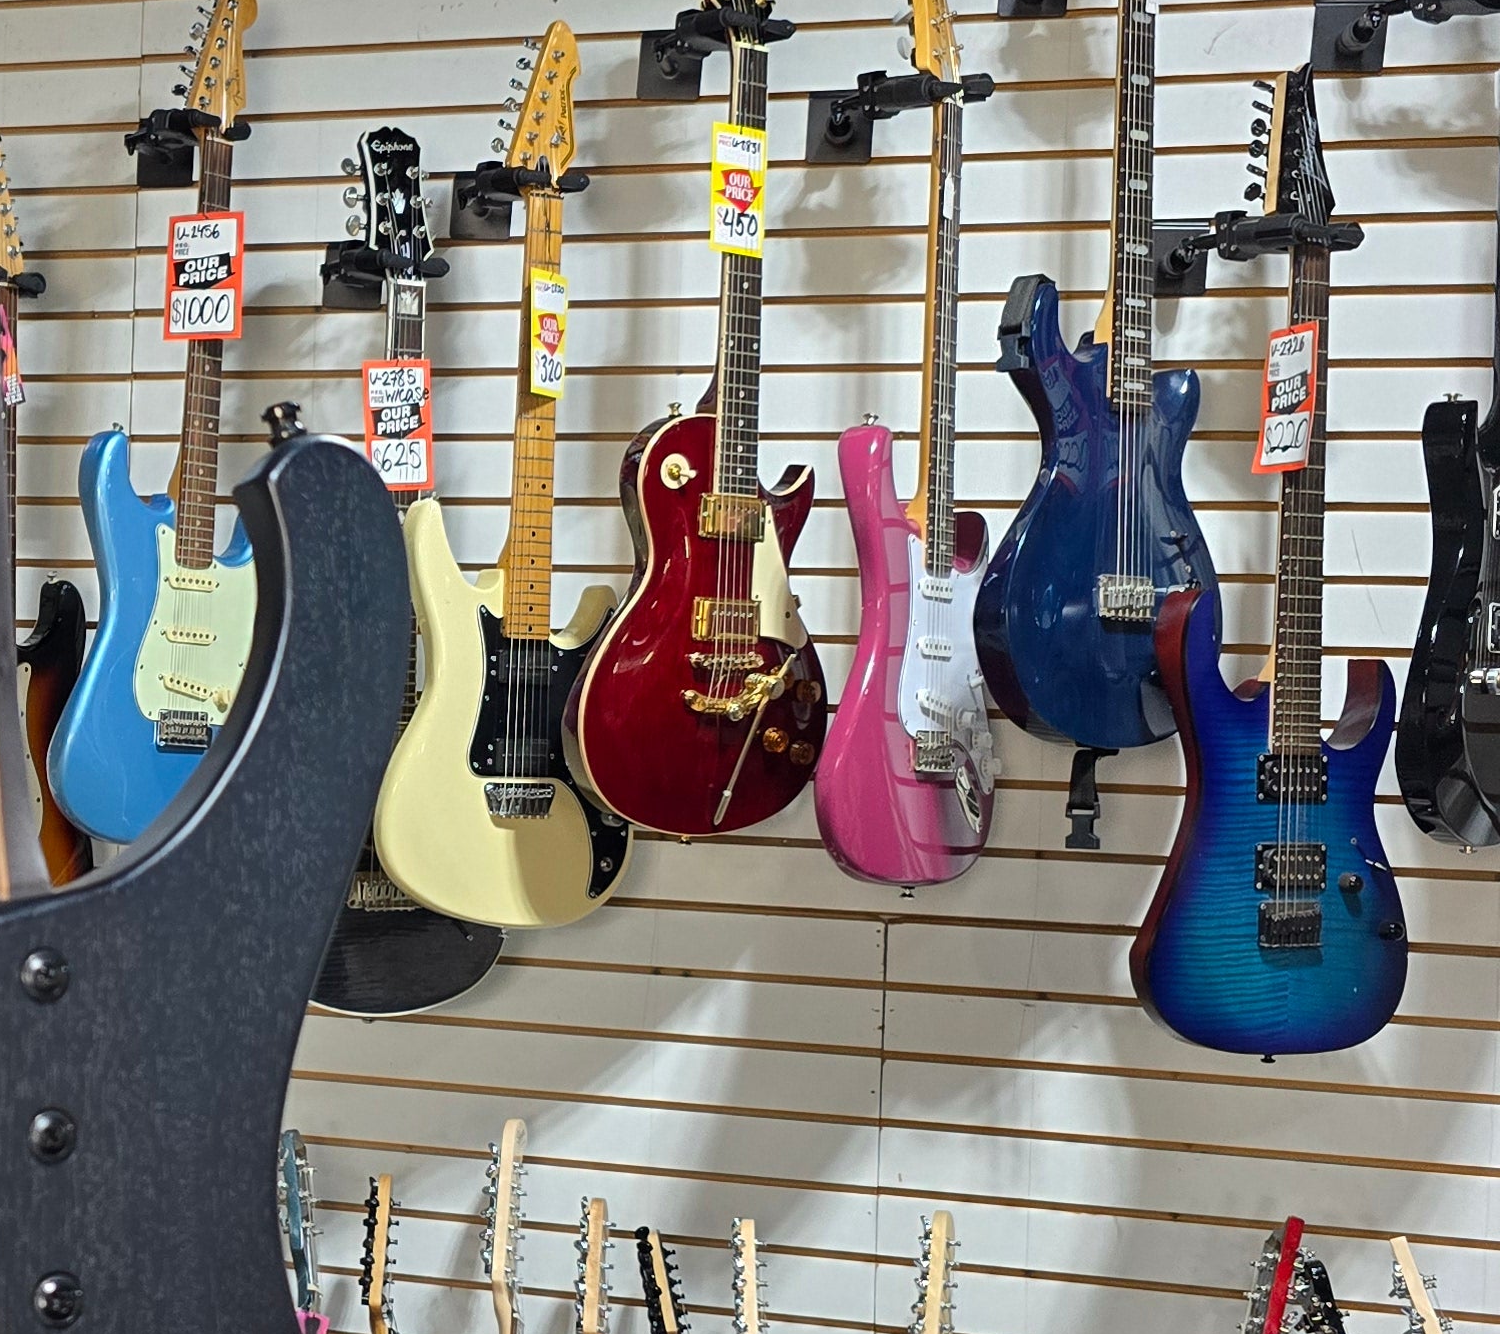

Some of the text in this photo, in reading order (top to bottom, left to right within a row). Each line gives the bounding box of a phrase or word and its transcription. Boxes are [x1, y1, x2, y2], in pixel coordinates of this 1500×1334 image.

[370, 139, 414, 154] Epiphone
[729, 172, 752, 189] OUR
[725, 185, 755, 203] PRICE
[184, 256, 220, 273] OUR
[178, 265, 228, 287] PRICE
[172, 293, 231, 330] $1000
[542, 317, 558, 331] OUR
[540, 329, 560, 346] PRICE
[1275, 374, 1303, 397] OUR
[1271, 387, 1307, 413] PRICE
[381, 405, 412, 422] OUR
[377, 415, 420, 436] PRICE
[373, 441, 422, 473] $625
